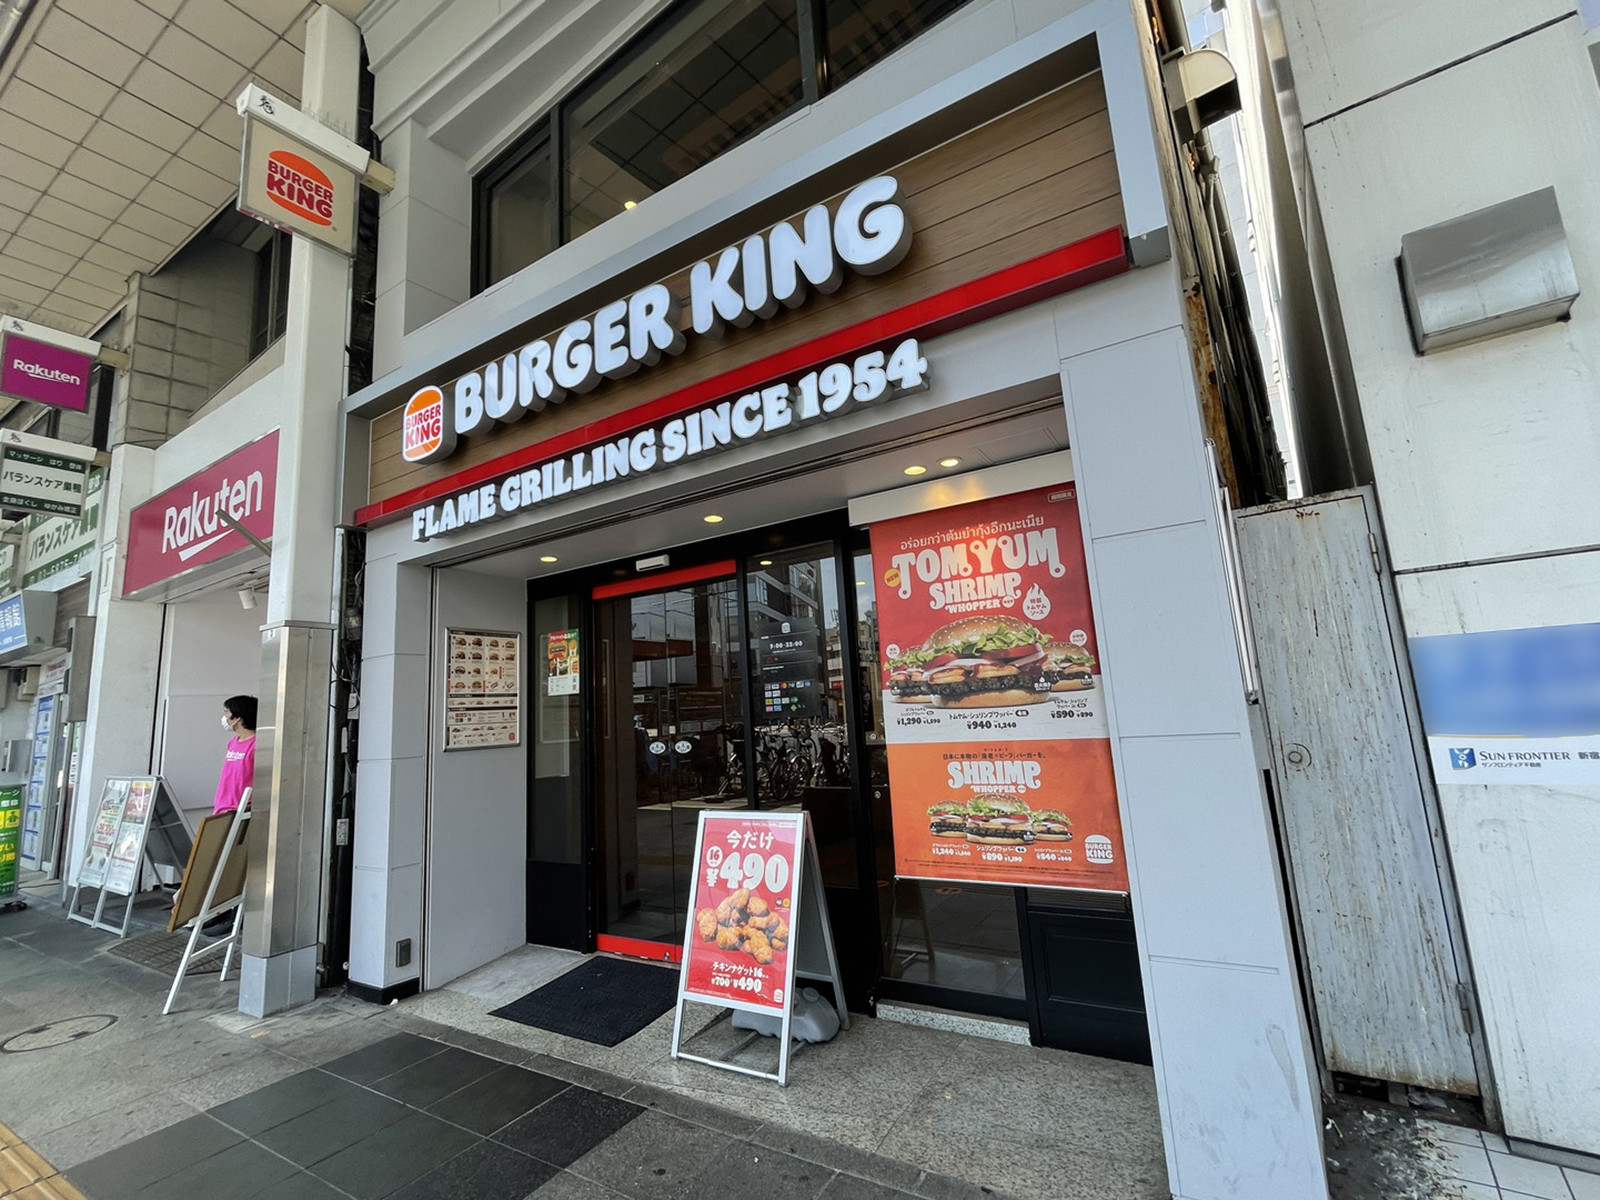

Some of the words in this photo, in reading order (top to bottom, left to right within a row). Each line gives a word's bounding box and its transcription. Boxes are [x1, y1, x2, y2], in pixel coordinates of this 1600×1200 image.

[267, 172, 332, 218] KING
[268, 160, 333, 203] BURGER
[455, 284, 674, 434] BURGER
[690, 175, 905, 334] KING
[13, 358, 80, 386] Rakuten
[406, 404, 442, 430] BURGER
[405, 419, 441, 449] KING
[412, 484, 496, 541] FLAME
[500, 428, 656, 512] GRILLING
[662, 383, 792, 462] SINCE
[798, 338, 927, 419] 1954
[162, 470, 263, 554] Rakuten
[892, 543, 973, 600] TOM
[970, 528, 1066, 578] YUM
[929, 572, 1022, 610] SHRIMP
[945, 599, 1000, 614] WHOPPER
[897, 717, 922, 726] ¥1,290
[967, 720, 992, 730] ¥940
[994, 722, 1016, 730] ¥1,240
[1051, 710, 1074, 718] ¥590
[1479, 750, 1506, 760] SUN
[1508, 752, 1571, 760] FRONTIER
[947, 760, 1042, 789] SHRIMP
[970, 785, 1016, 794] WHOPPER
[726, 830, 774, 850] 今だけ
[710, 849, 720, 861] 16
[1087, 850, 1113, 860] KING
[706, 852, 789, 894] ¥490
[733, 976, 762, 993] ¥490
